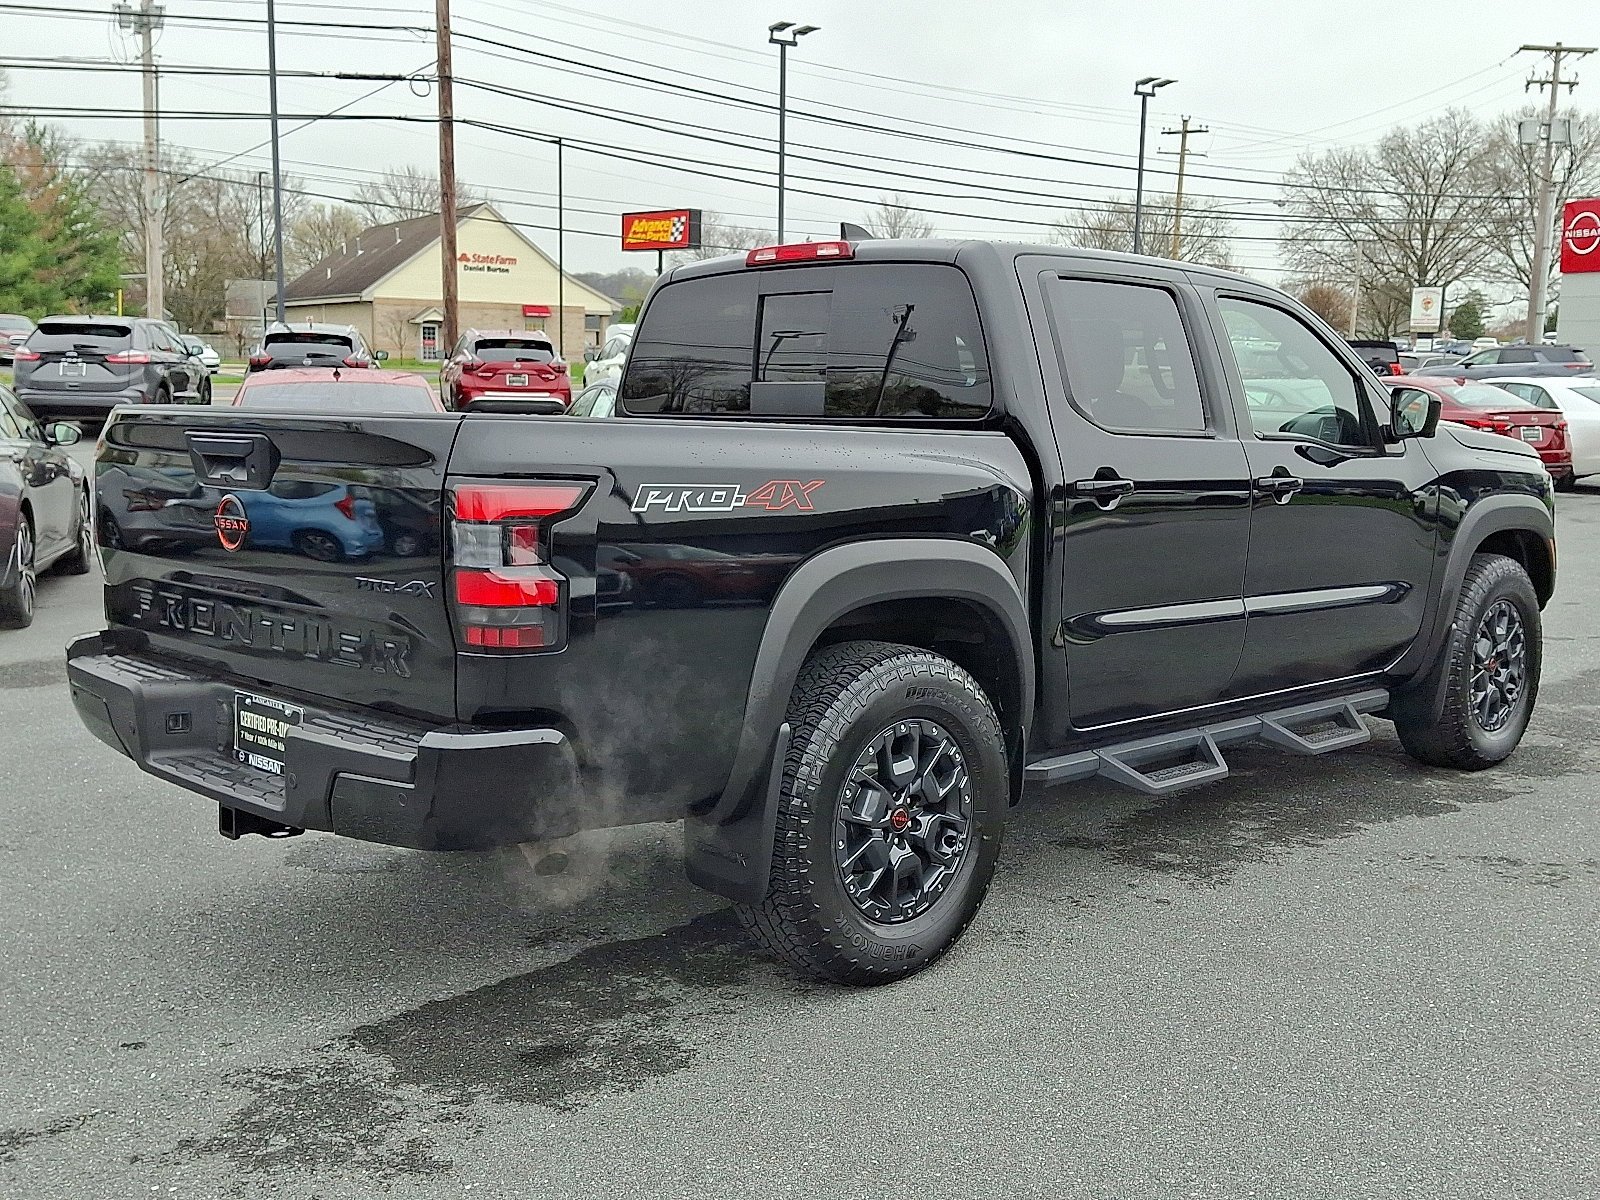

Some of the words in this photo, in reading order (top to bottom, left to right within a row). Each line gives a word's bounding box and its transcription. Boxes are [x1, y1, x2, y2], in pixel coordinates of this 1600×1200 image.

[463, 264, 485, 272] Daniel
[130, 585, 412, 679] FRONTIER
[240, 710, 267, 733] CERTIFIED
[248, 753, 281, 775] NISSAN
